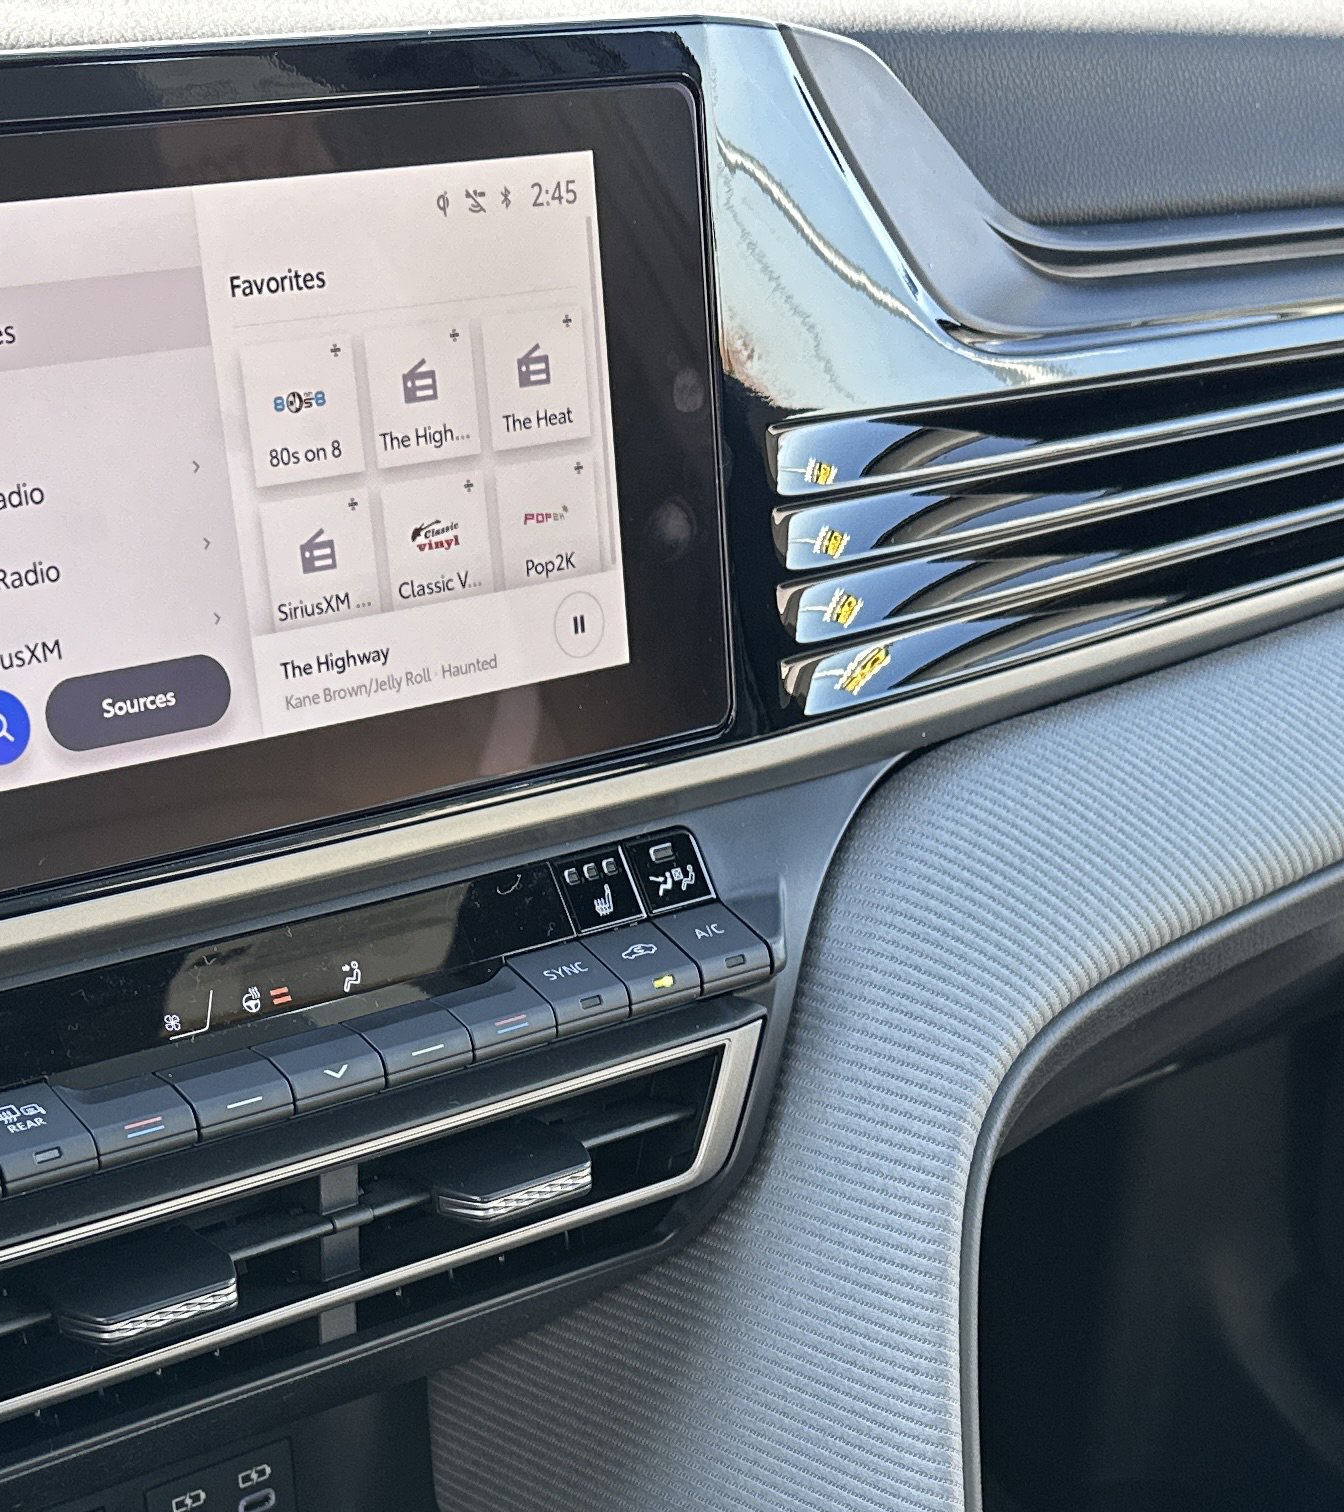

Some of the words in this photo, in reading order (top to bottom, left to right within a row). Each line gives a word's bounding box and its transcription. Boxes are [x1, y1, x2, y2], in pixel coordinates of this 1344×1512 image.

[530, 180, 578, 208] 2:45
[229, 268, 327, 298] Favorites
[502, 414, 533, 434] The
[535, 407, 574, 428] Heat
[268, 448, 301, 468] 80s
[303, 446, 328, 463] on
[331, 440, 343, 459] 8
[378, 432, 412, 452] The
[416, 535, 461, 552] vinyl
[423, 522, 460, 540] Classic
[525, 551, 577, 578] Pop2K
[398, 573, 455, 600] Classic
[277, 592, 351, 623] SiriusXM
[280, 661, 314, 681] The
[316, 647, 391, 674] Highway
[284, 691, 321, 711] Kane
[323, 673, 403, 704] Brown/Jelly
[405, 668, 433, 688] Roll
[441, 654, 499, 680] Haunted
[102, 691, 177, 719] Sources
[694, 923, 726, 940] A/C
[543, 961, 590, 982] SYNC
[6, 1116, 47, 1134] REAR
